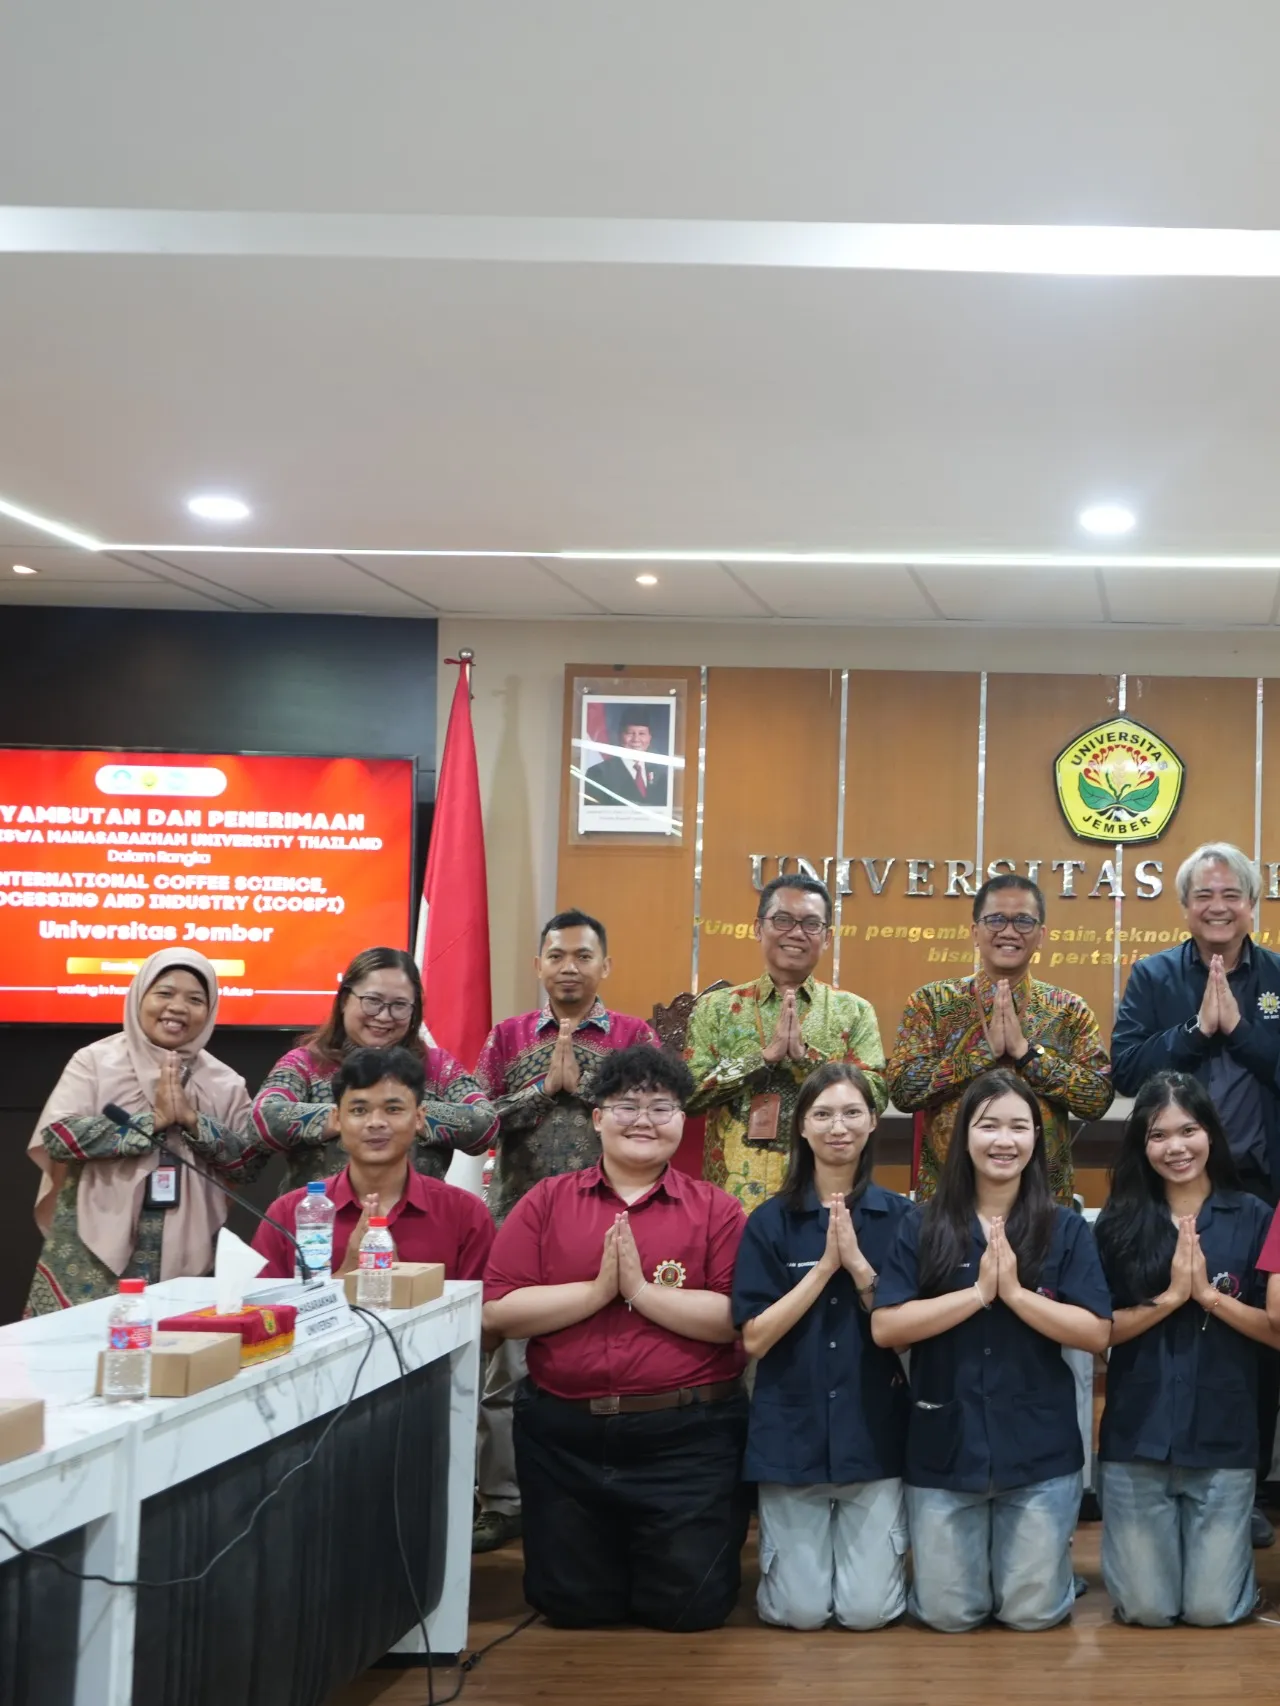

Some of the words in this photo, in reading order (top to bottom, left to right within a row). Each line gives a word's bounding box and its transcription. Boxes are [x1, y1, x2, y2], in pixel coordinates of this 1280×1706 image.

[1071, 732, 1167, 770] UNIVERSITA
[147, 809, 201, 827] DAN
[208, 811, 365, 831] PENERIMAAN
[1082, 815, 1151, 833] JEMBER
[191, 833, 294, 848] UNIVERSITY
[297, 836, 383, 850] THAILAND
[153, 874, 230, 890] COFFEE
[234, 875, 327, 894] SCIENCE,
[103, 893, 145, 908] AND
[149, 894, 249, 911] INDUSTRY
[39, 919, 178, 940] Universitas
[182, 922, 274, 942] Jember
[865, 924, 971, 943] pengemb
[1105, 927, 1193, 943] teknolo
